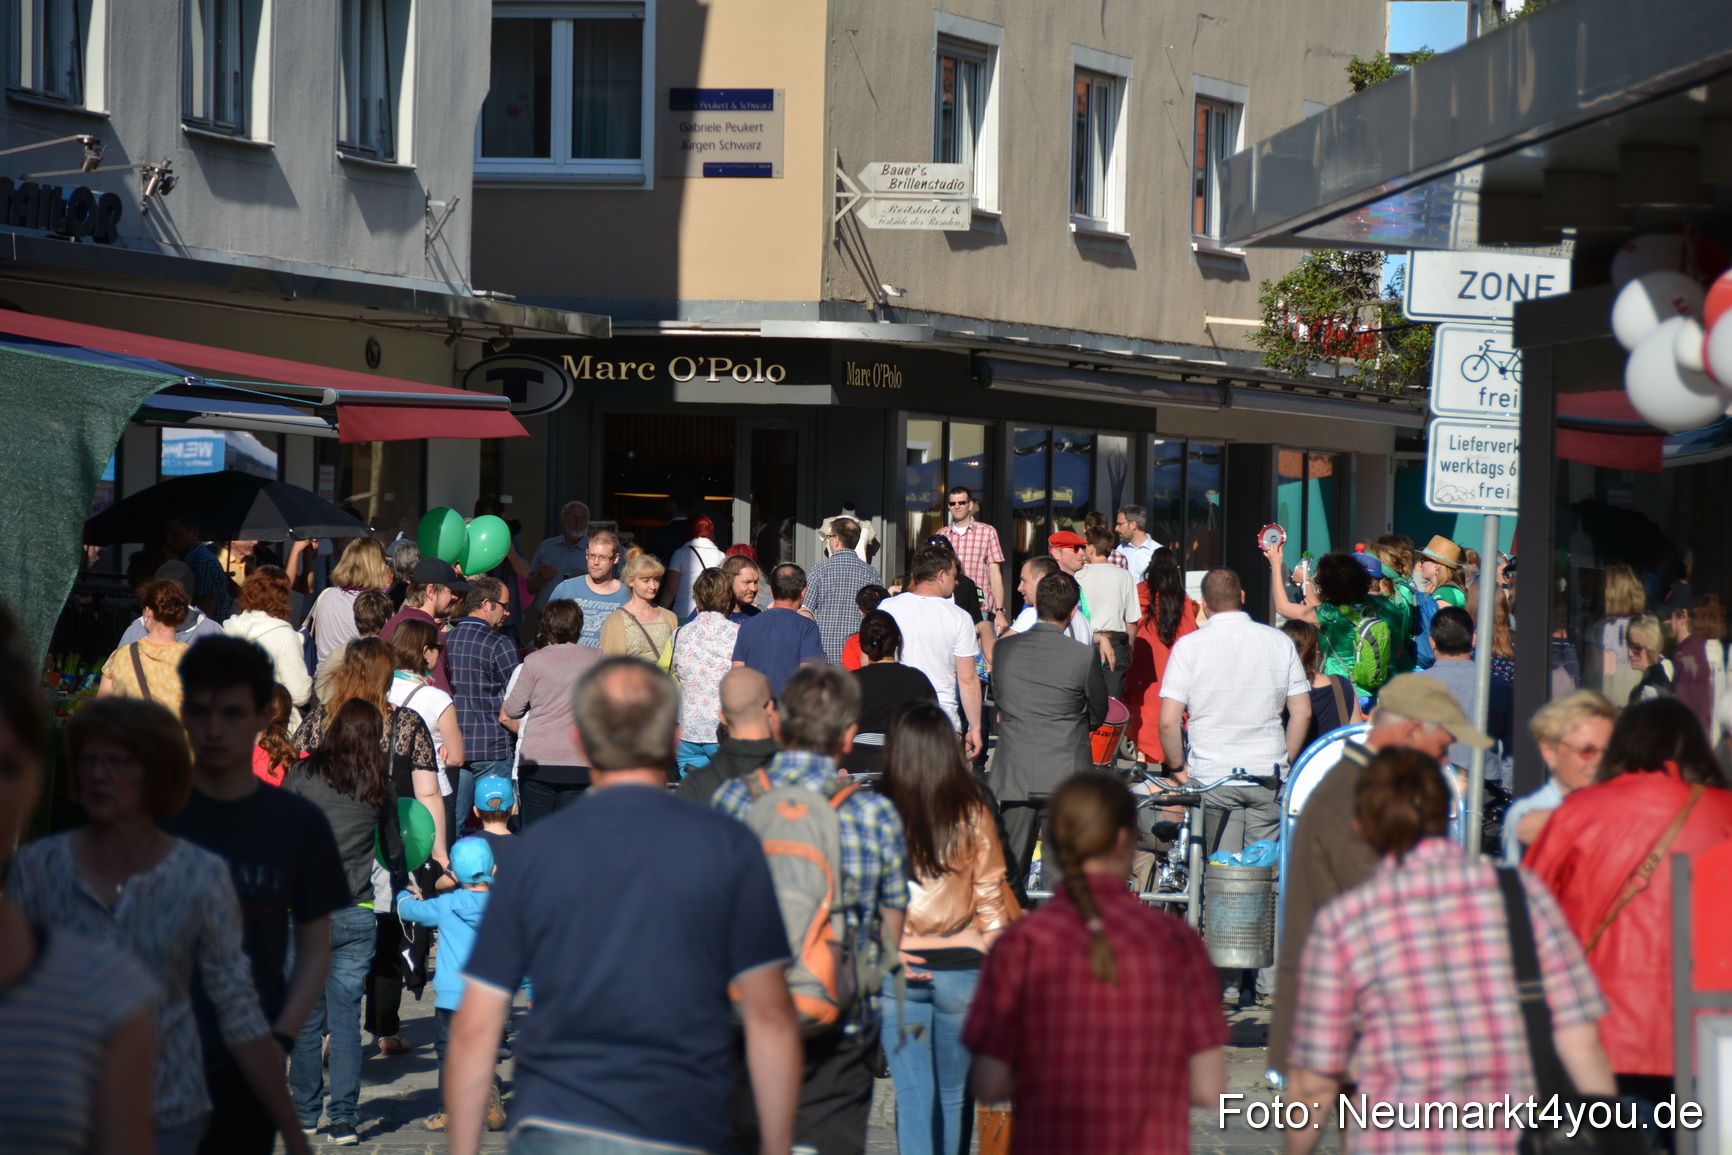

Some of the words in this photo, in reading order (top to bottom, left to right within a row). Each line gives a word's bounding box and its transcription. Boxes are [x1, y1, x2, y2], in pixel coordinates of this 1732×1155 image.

[679, 121, 722, 133] Gabriele
[725, 121, 764, 133] Peukert
[680, 139, 716, 153] Jürgen
[719, 139, 762, 151] Schwarz
[880, 163, 928, 176] Bauer's
[887, 177, 965, 190] Brillenstudio
[882, 203, 950, 215] Reitstadel
[952, 205, 962, 215] &
[1457, 270, 1555, 302] ZONE
[559, 355, 656, 381] Marc
[668, 355, 787, 384] O'Polo
[846, 361, 871, 387] Marc
[873, 362, 902, 389] O'Polo
[1478, 386, 1519, 409] frei
[1439, 457, 1505, 480] werktags
[1508, 460, 1518, 477] 6
[1478, 482, 1511, 500] frei
